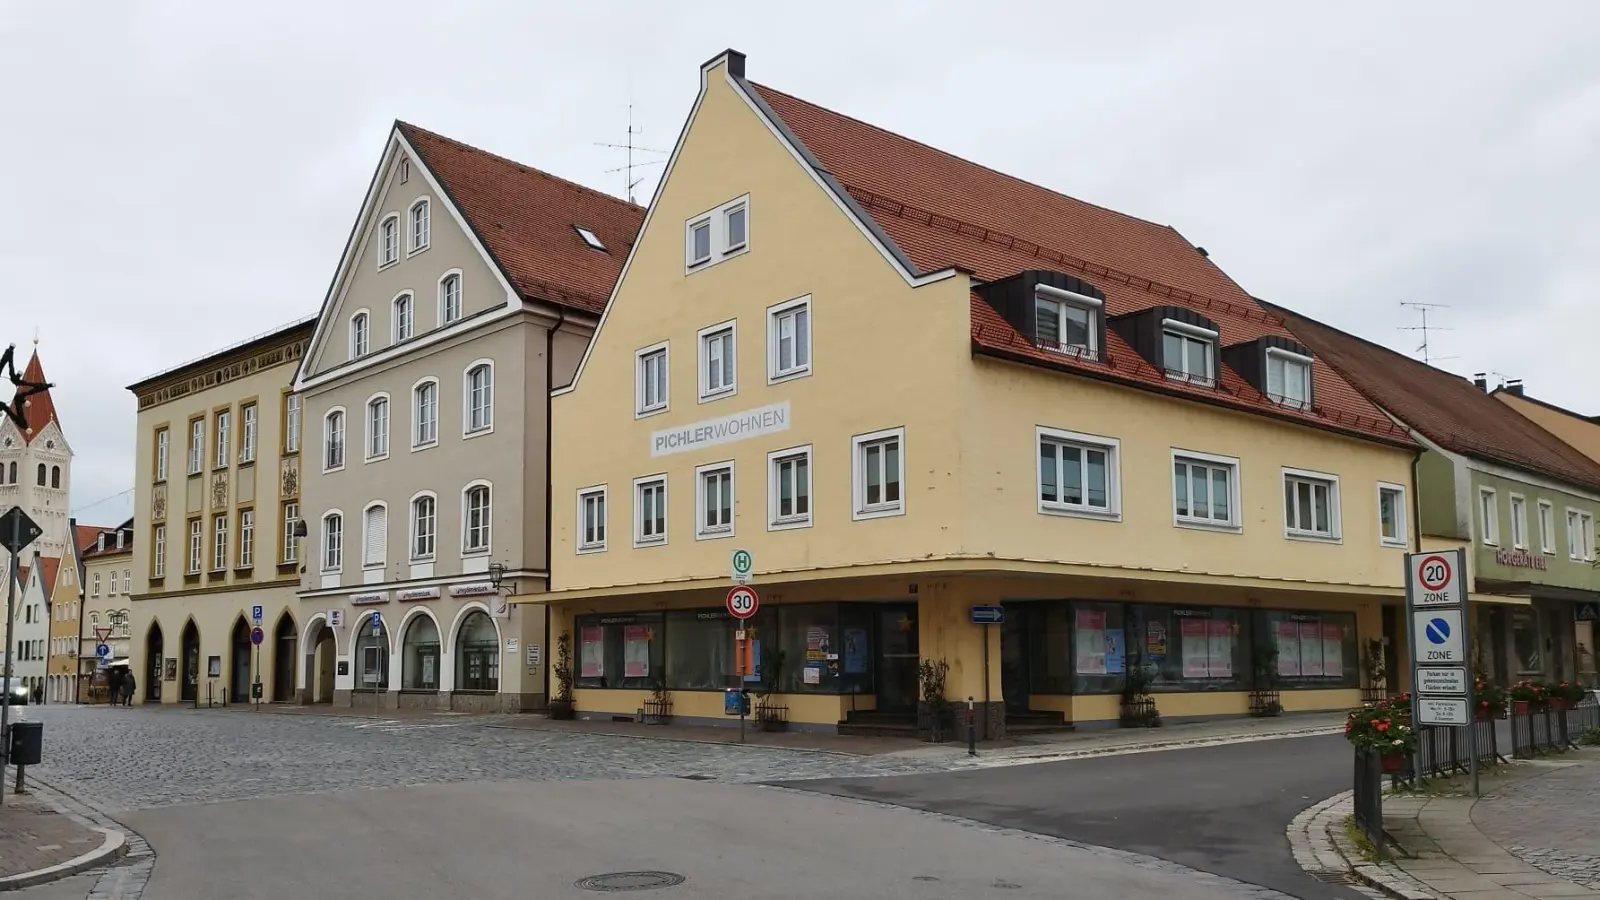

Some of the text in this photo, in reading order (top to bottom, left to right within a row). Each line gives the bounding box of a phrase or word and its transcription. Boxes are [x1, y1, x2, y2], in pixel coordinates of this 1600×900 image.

[655, 408, 785, 451] PICHLERWOHNEN
[738, 555, 747, 568] H
[1426, 565, 1444, 581] 20
[733, 595, 752, 610] 30
[1424, 592, 1449, 603] ZONE
[1427, 650, 1452, 660] ZONE
